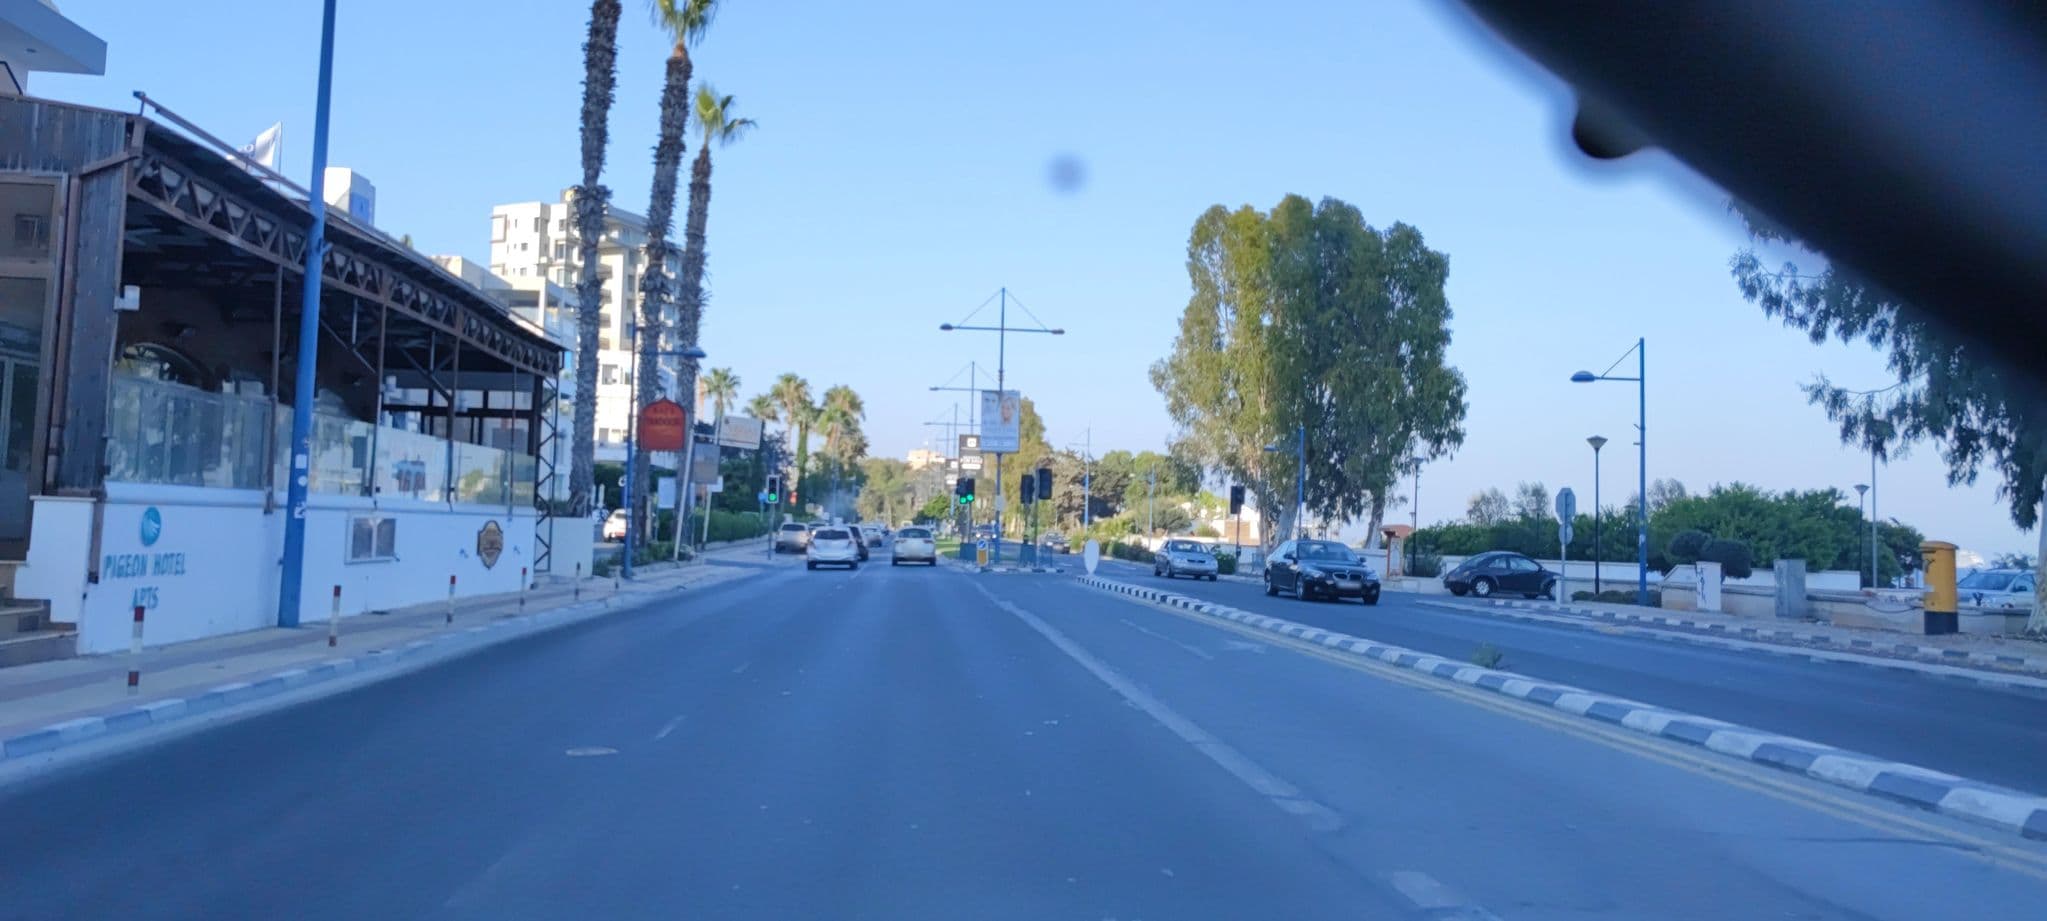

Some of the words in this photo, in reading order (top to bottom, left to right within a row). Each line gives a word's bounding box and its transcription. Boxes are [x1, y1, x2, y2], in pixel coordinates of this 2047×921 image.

[103, 554, 148, 579] PIGEON
[153, 552, 185, 576] HOTEL
[131, 586, 159, 609] APTS
